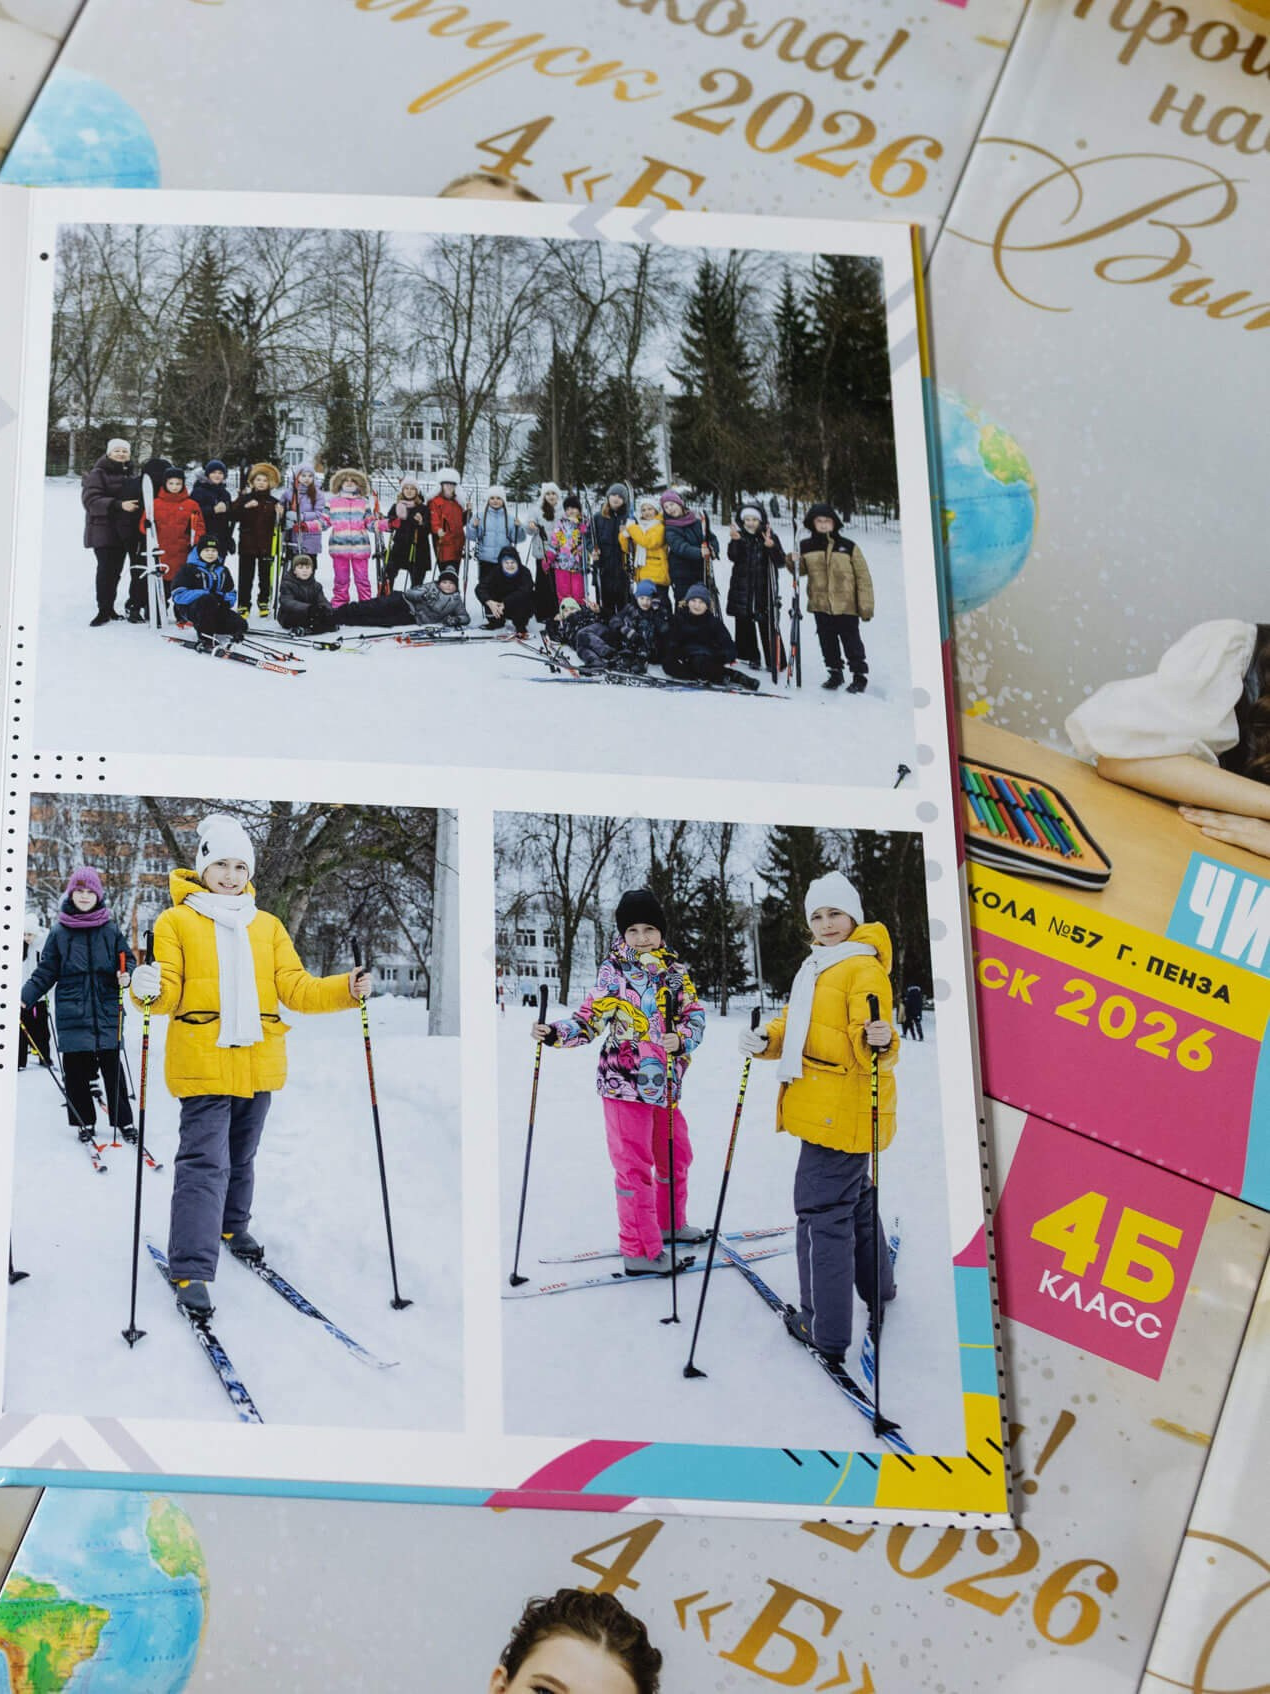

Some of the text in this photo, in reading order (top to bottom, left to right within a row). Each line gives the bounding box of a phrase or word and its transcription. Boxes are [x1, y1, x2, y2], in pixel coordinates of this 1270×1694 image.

[475, 115, 555, 182] 4
[672, 68, 943, 198] 2026
[1047, 915, 1104, 950] №57
[1145, 954, 1231, 1005] ПЕНЗА
[973, 951, 1217, 1073] СК 2026
[1030, 1190, 1184, 1304] 4Б
[1038, 1269, 1163, 1340] КЛАСС
[572, 1518, 665, 1595] 4
